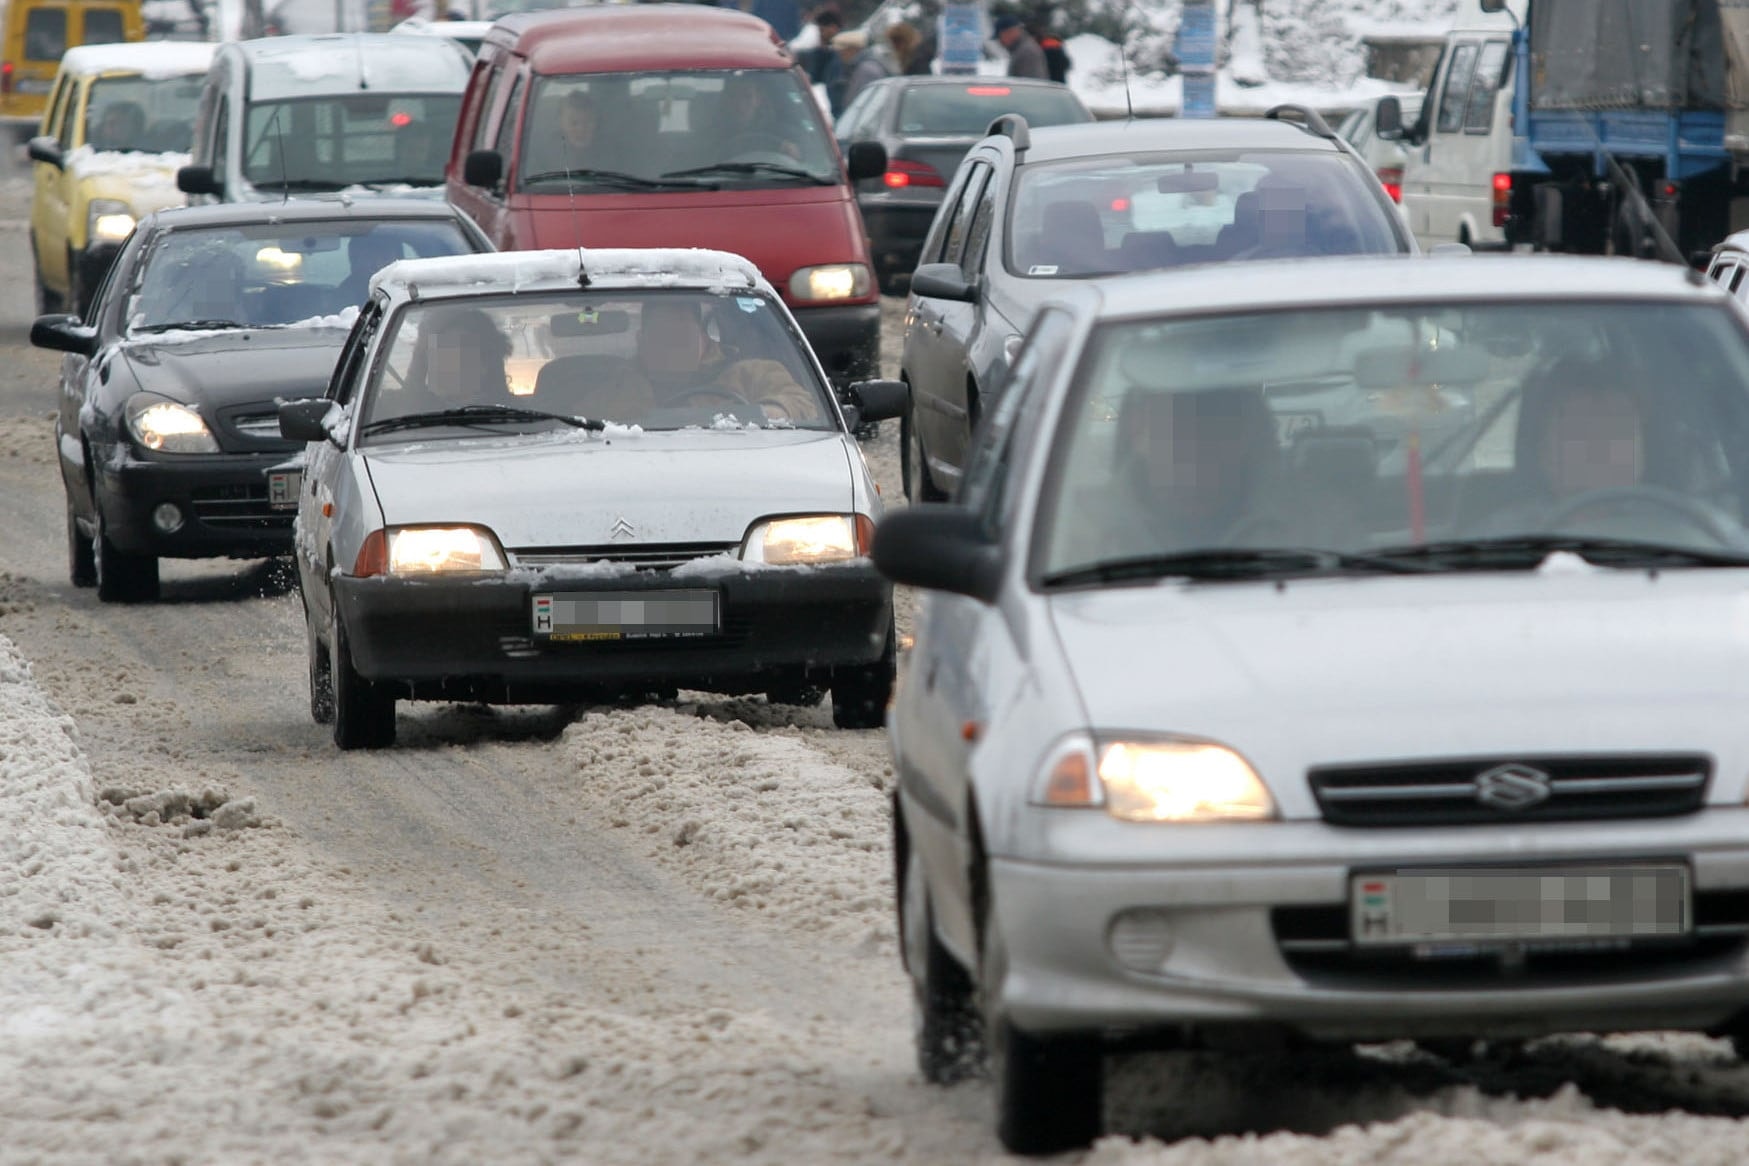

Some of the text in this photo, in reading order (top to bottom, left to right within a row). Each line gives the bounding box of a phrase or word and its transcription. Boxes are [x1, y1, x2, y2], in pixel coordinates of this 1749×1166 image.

[273, 490, 285, 501] H
[537, 615, 551, 629] H
[1363, 912, 1388, 934] H
